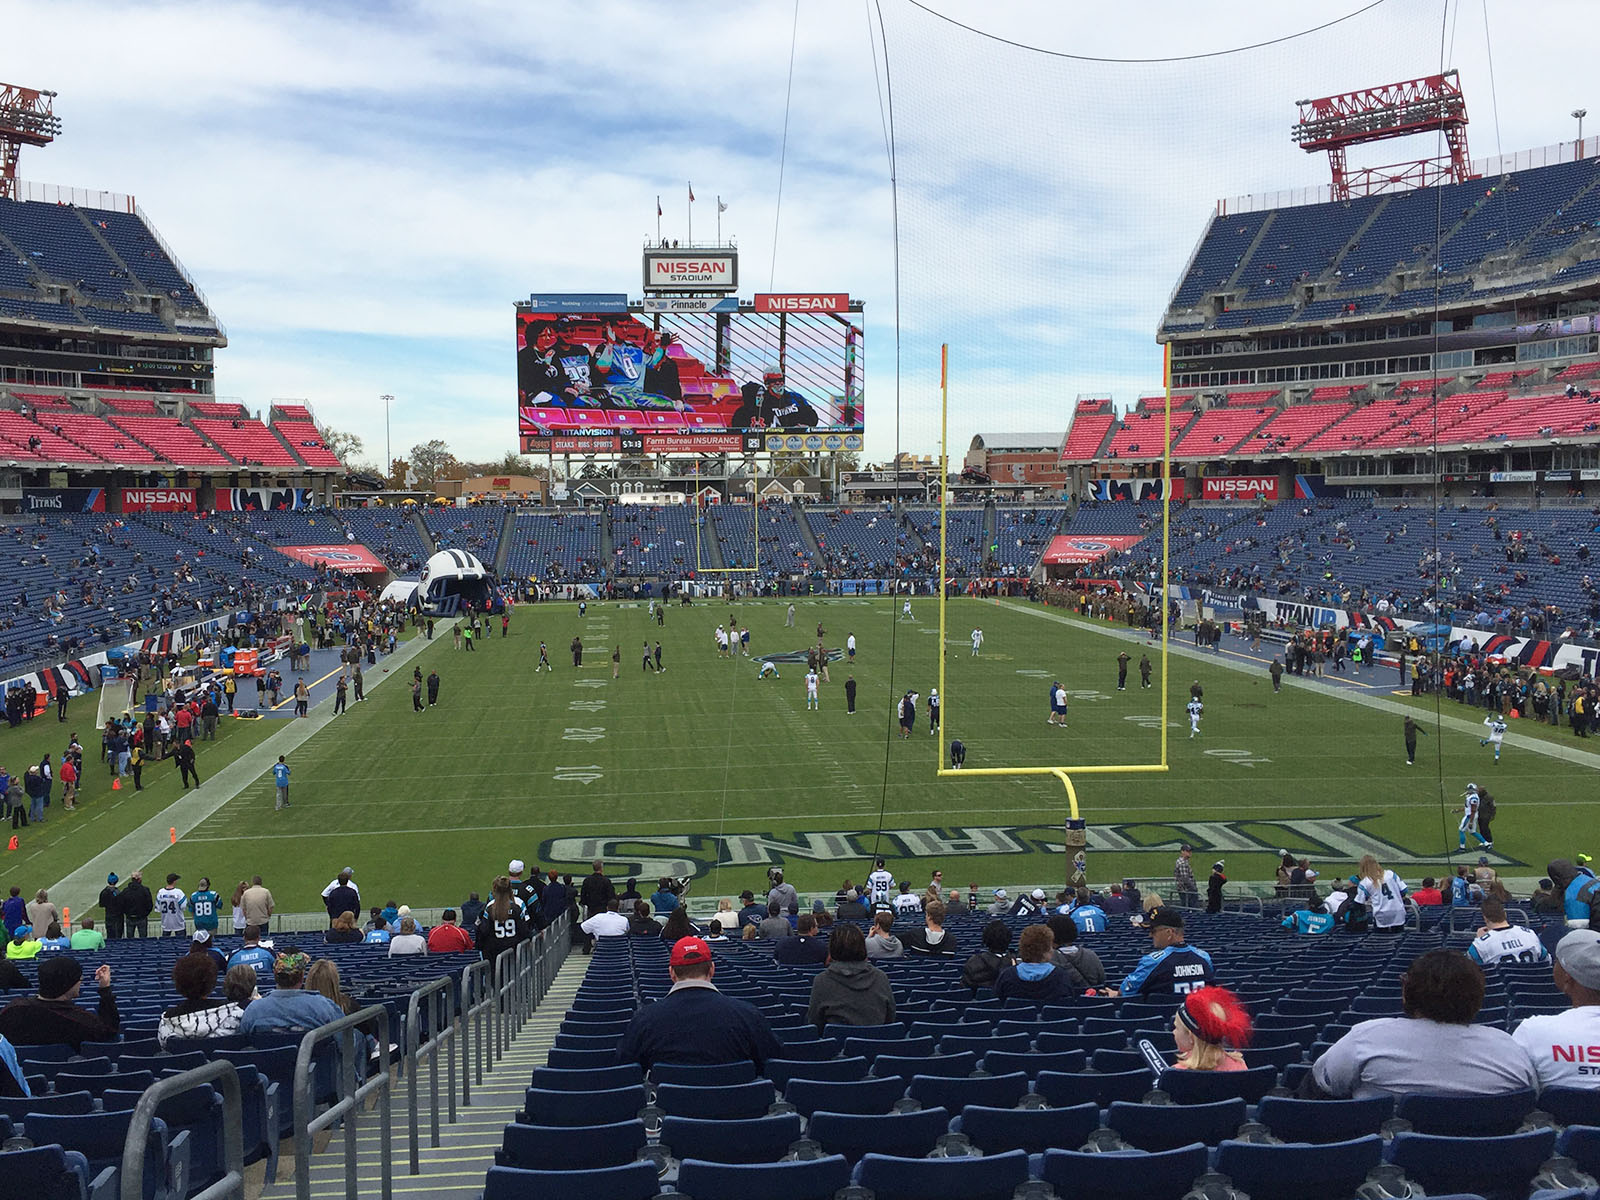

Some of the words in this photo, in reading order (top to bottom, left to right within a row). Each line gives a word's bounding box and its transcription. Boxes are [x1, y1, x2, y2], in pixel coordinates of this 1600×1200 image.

[657, 262, 725, 273] NISSAN
[671, 300, 707, 310] Pinnacle
[768, 297, 836, 309] NISSAN
[562, 428, 613, 436] TITANVISION
[593, 440, 613, 448] SPIRITS
[646, 437, 665, 445] Farm
[667, 437, 692, 445] Bureau
[693, 436, 740, 445] INSURANCE
[1207, 479, 1274, 491] NISSAN
[28, 494, 62, 509] TITANS
[126, 492, 192, 503] NISSAN
[561, 727, 606, 740] 20
[552, 765, 604, 781] 10
[537, 815, 1531, 888] TITANS
[876, 881, 888, 892] 59
[160, 900, 177, 914] 34
[195, 901, 212, 916] 88
[494, 918, 517, 938] 59
[1173, 963, 1205, 977] JOHNSON
